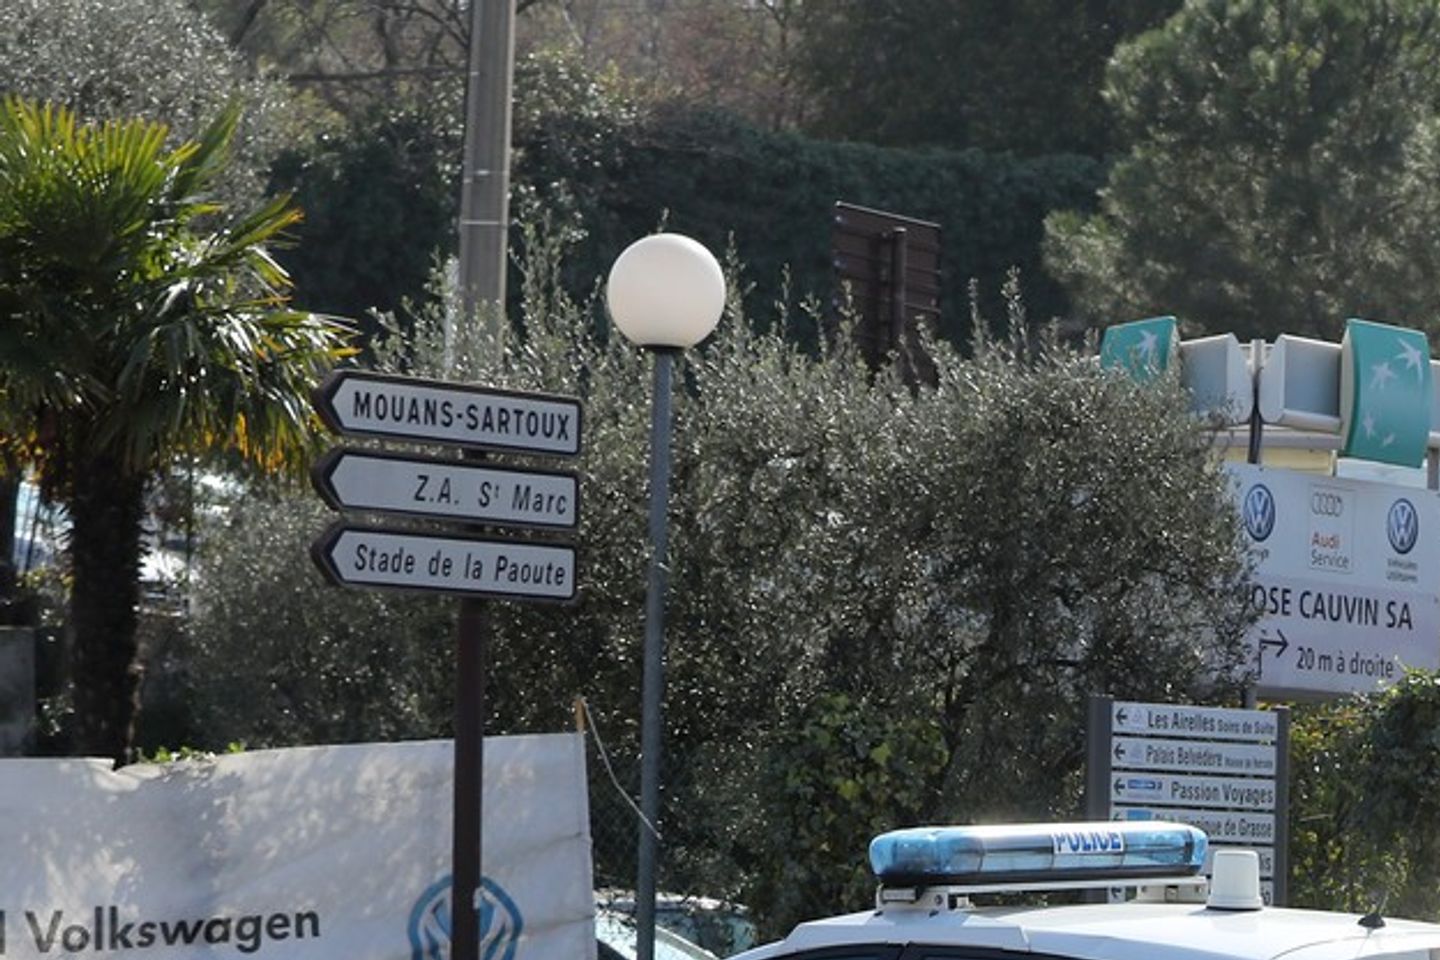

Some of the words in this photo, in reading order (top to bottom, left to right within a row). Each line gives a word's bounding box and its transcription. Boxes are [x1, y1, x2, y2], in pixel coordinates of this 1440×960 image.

[353, 391, 570, 441] MOUANS-SARTOUX
[414, 475, 460, 505] Z.A.
[512, 484, 567, 515] Marc
[1310, 551, 1350, 570] Service
[1311, 532, 1341, 549] Audi
[354, 544, 416, 575] Stade
[428, 551, 453, 577] de
[464, 553, 482, 580] la
[494, 556, 566, 586] Paoute
[1250, 585, 1292, 616] OSE
[1299, 590, 1378, 626] CAUVIN
[1386, 600, 1413, 631] SA
[1297, 647, 1316, 671] 20
[1318, 653, 1334, 672] m
[1337, 651, 1346, 674] à
[1350, 651, 1394, 679] droite
[1171, 781, 1220, 801] Passion
[1222, 783, 1273, 807] Voyages
[25, 905, 321, 954] Volkswagen
